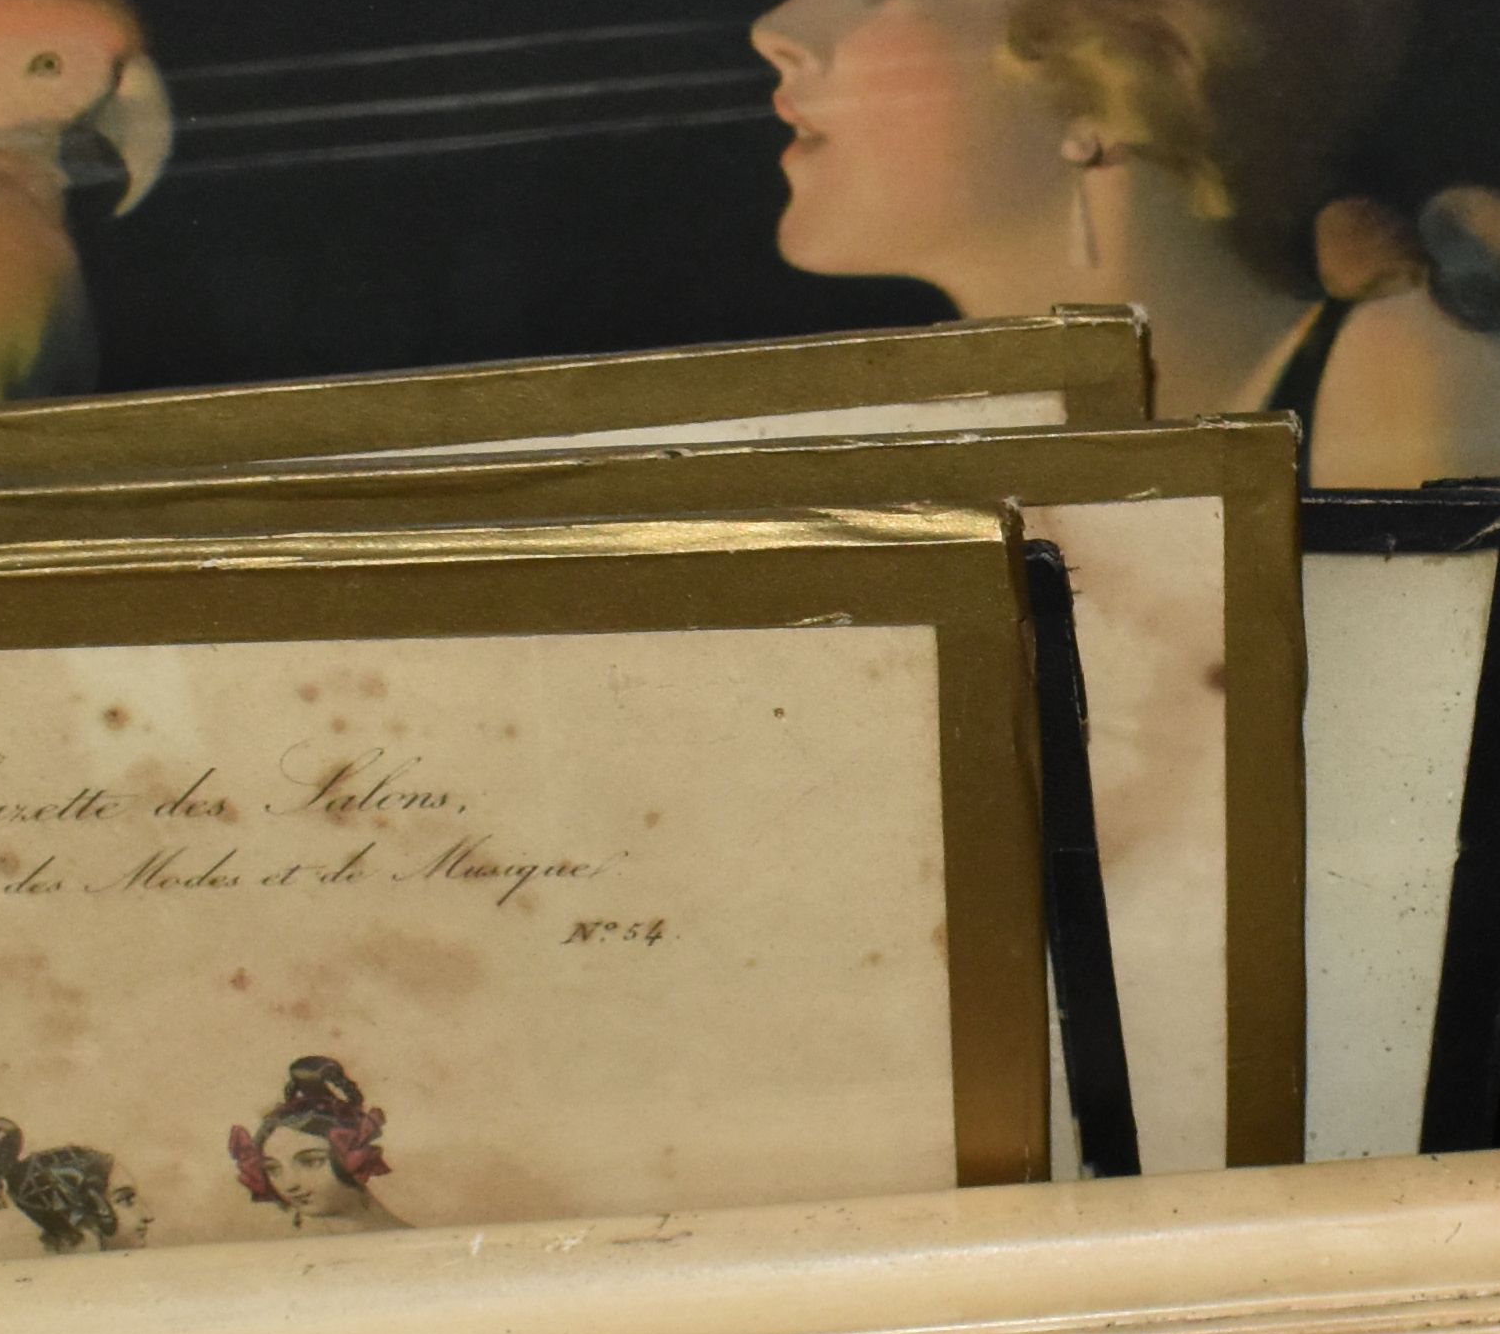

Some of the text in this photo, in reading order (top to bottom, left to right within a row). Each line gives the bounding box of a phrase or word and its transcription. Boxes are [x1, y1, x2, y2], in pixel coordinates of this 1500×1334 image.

[153, 767, 228, 817] des
[3, 855, 64, 896] des
[84, 845, 241, 893] Modes
